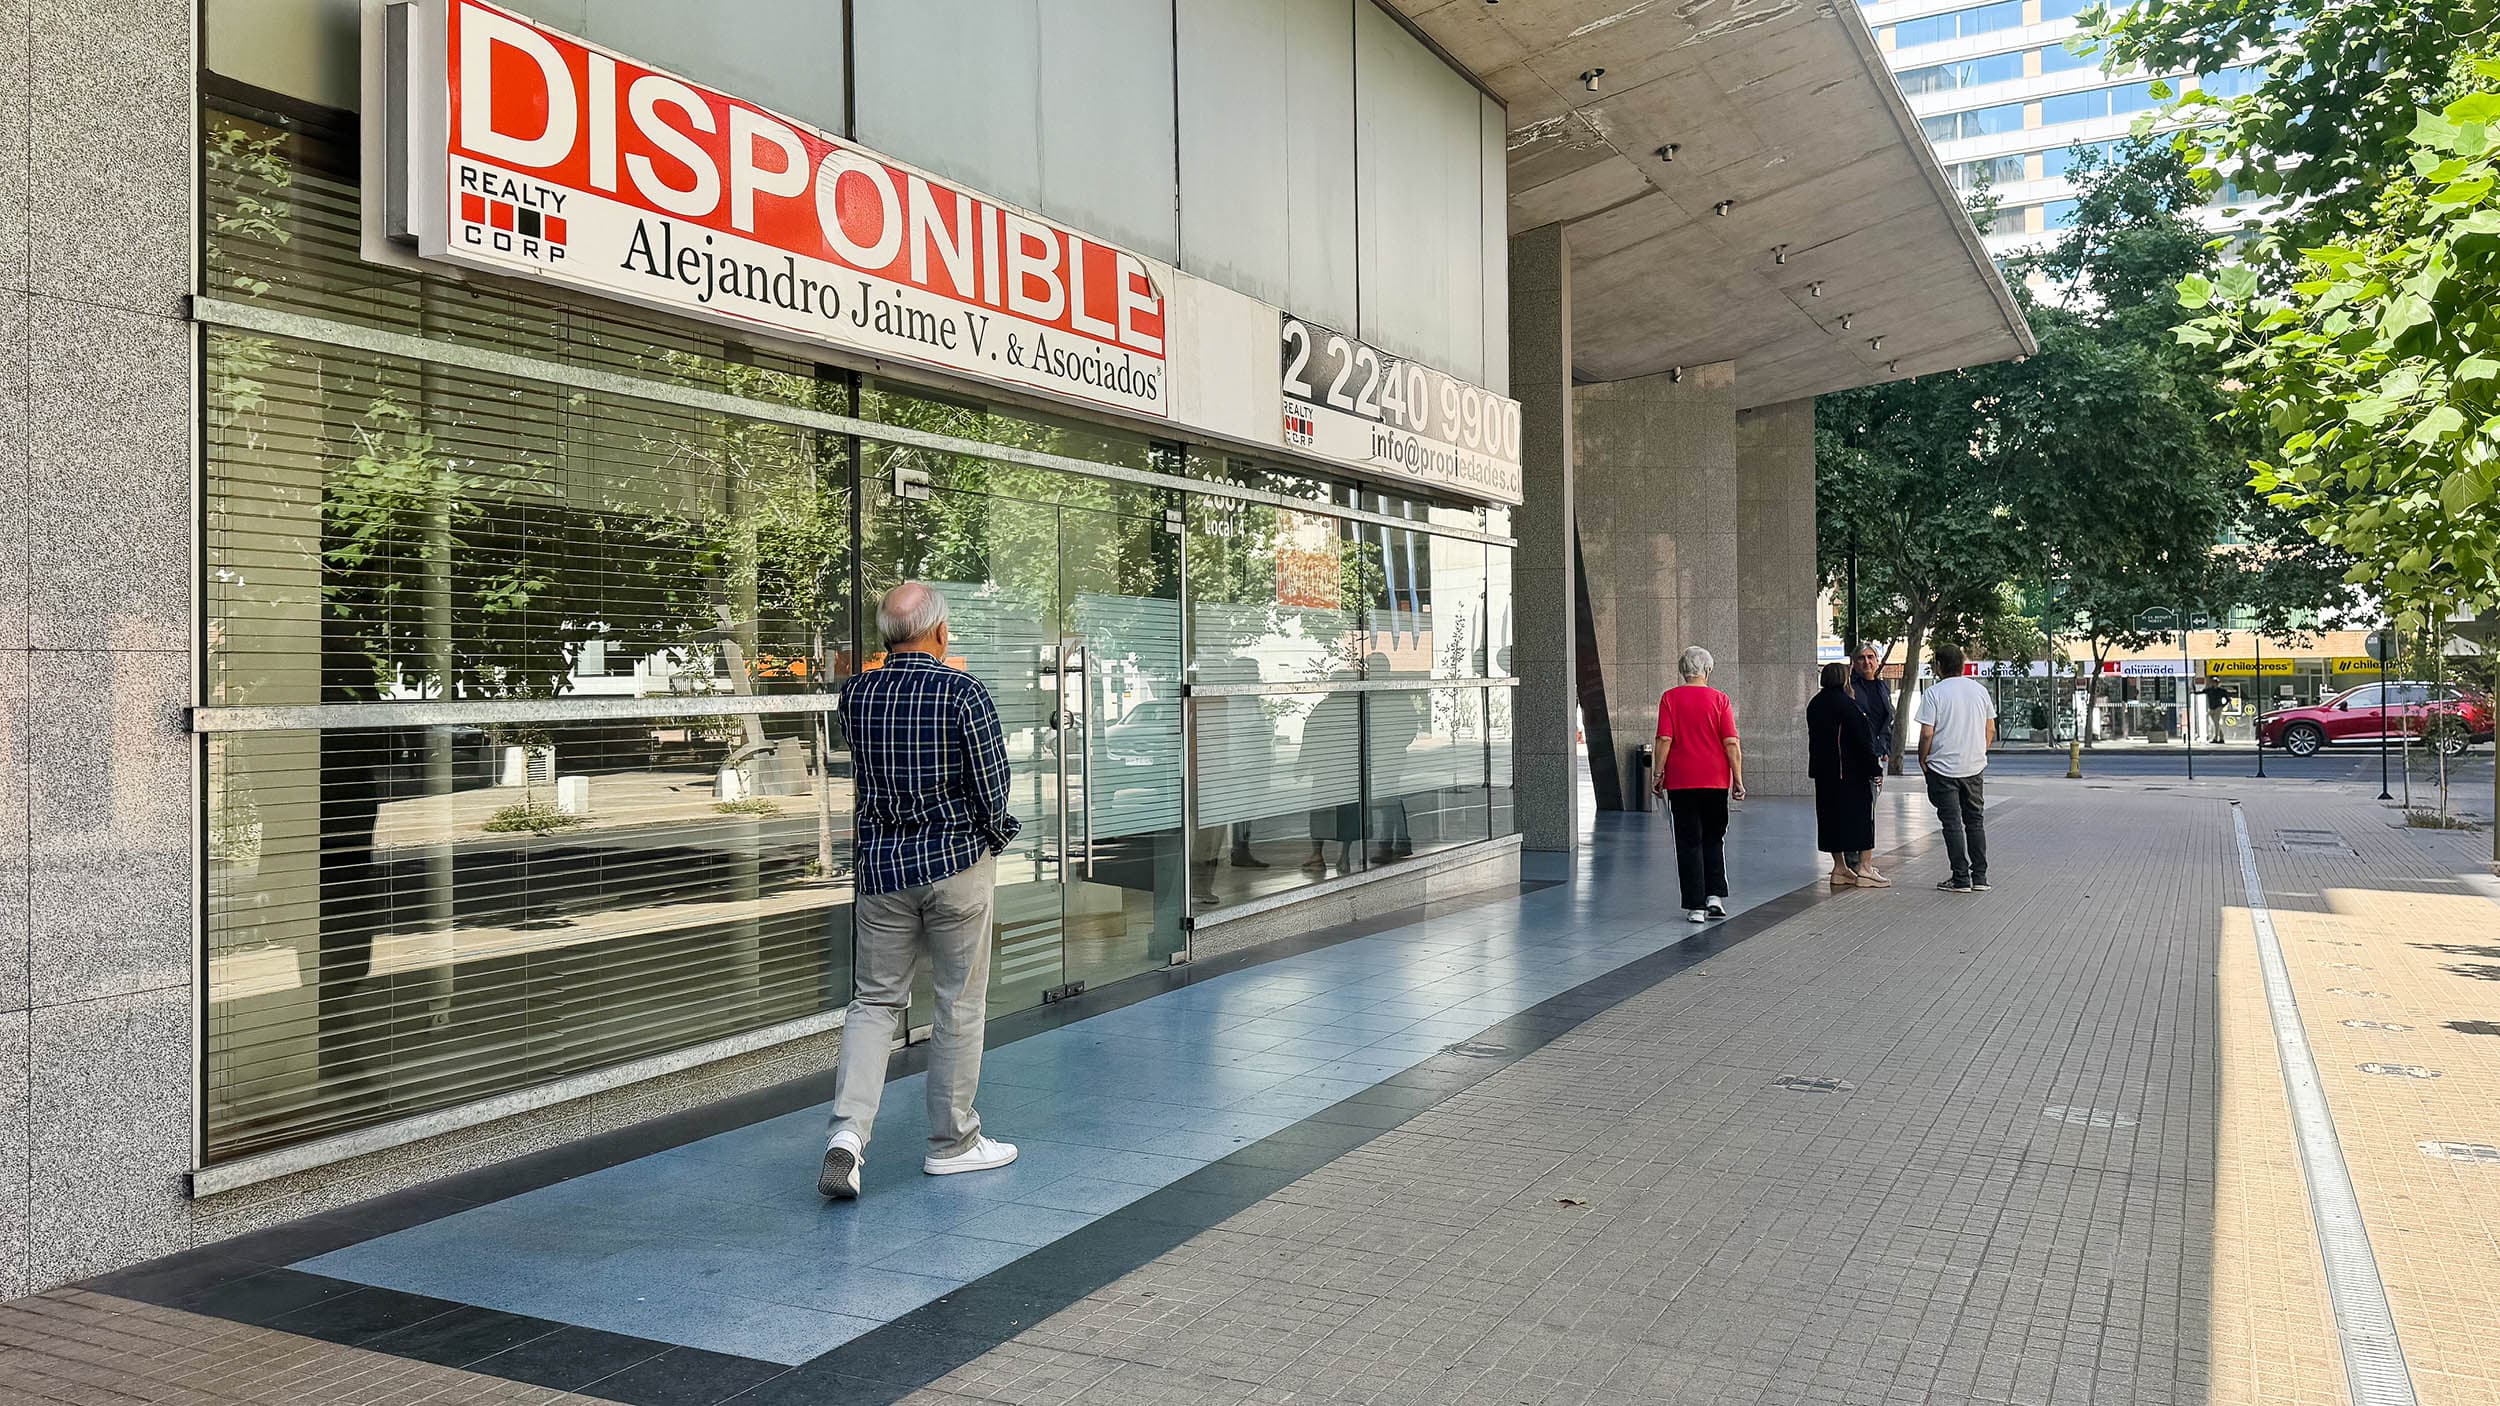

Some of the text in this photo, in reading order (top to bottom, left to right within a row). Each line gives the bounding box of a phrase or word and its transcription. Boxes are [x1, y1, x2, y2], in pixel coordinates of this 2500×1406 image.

[459, 1, 1163, 356] DISPONIBLE
[461, 165, 567, 213] REALTY
[465, 225, 565, 263] CORP
[620, 218, 1158, 401] Alejandro Jaime V. & Asociados
[1282, 320, 1521, 461] 2 2240 9900
[1283, 400, 1314, 420] REALTY
[1371, 425, 1520, 494] info@propiedades.cl
[1204, 513, 1246, 539] Local 4
[2124, 665, 2174, 675] ahumada
[2226, 661, 2288, 671] chilexpress
